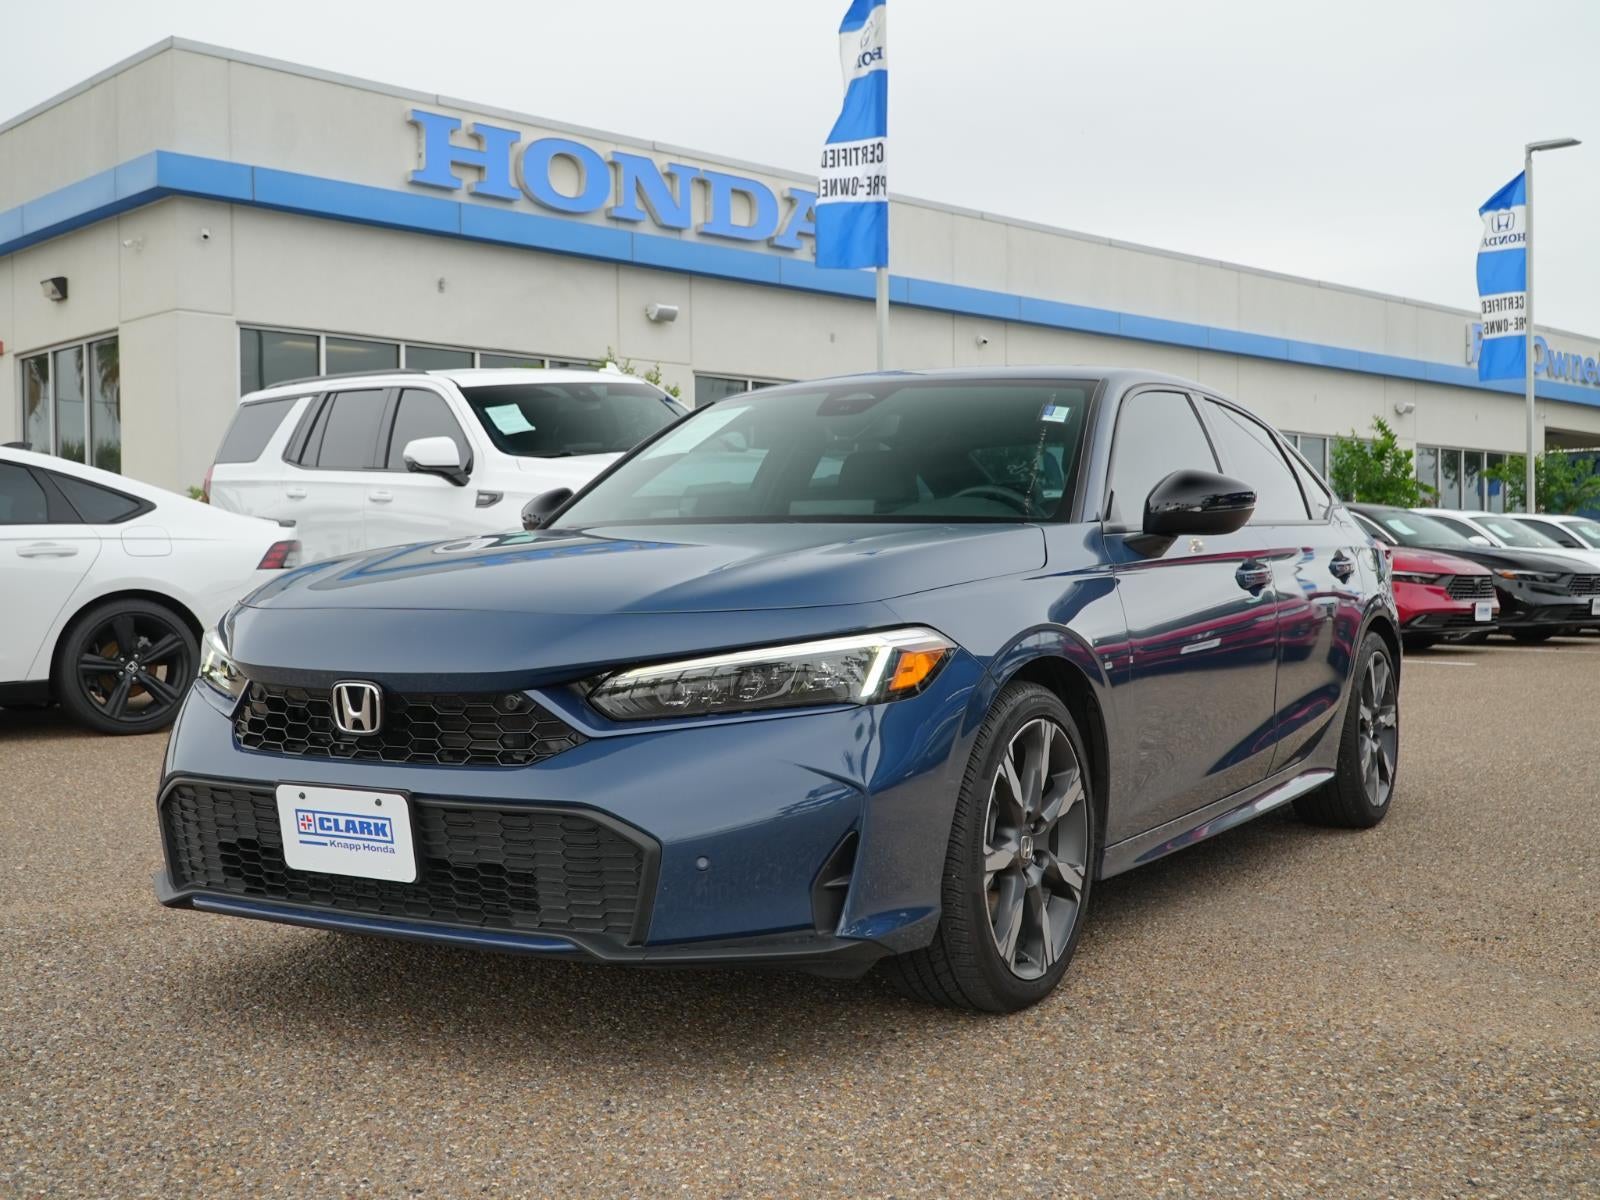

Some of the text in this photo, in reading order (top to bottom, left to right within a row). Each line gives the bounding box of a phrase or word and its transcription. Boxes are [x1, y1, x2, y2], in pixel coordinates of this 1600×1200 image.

[407, 109, 817, 252] HONDA
[318, 816, 389, 838] CLARK
[329, 840, 396, 854] Knapp Honda
